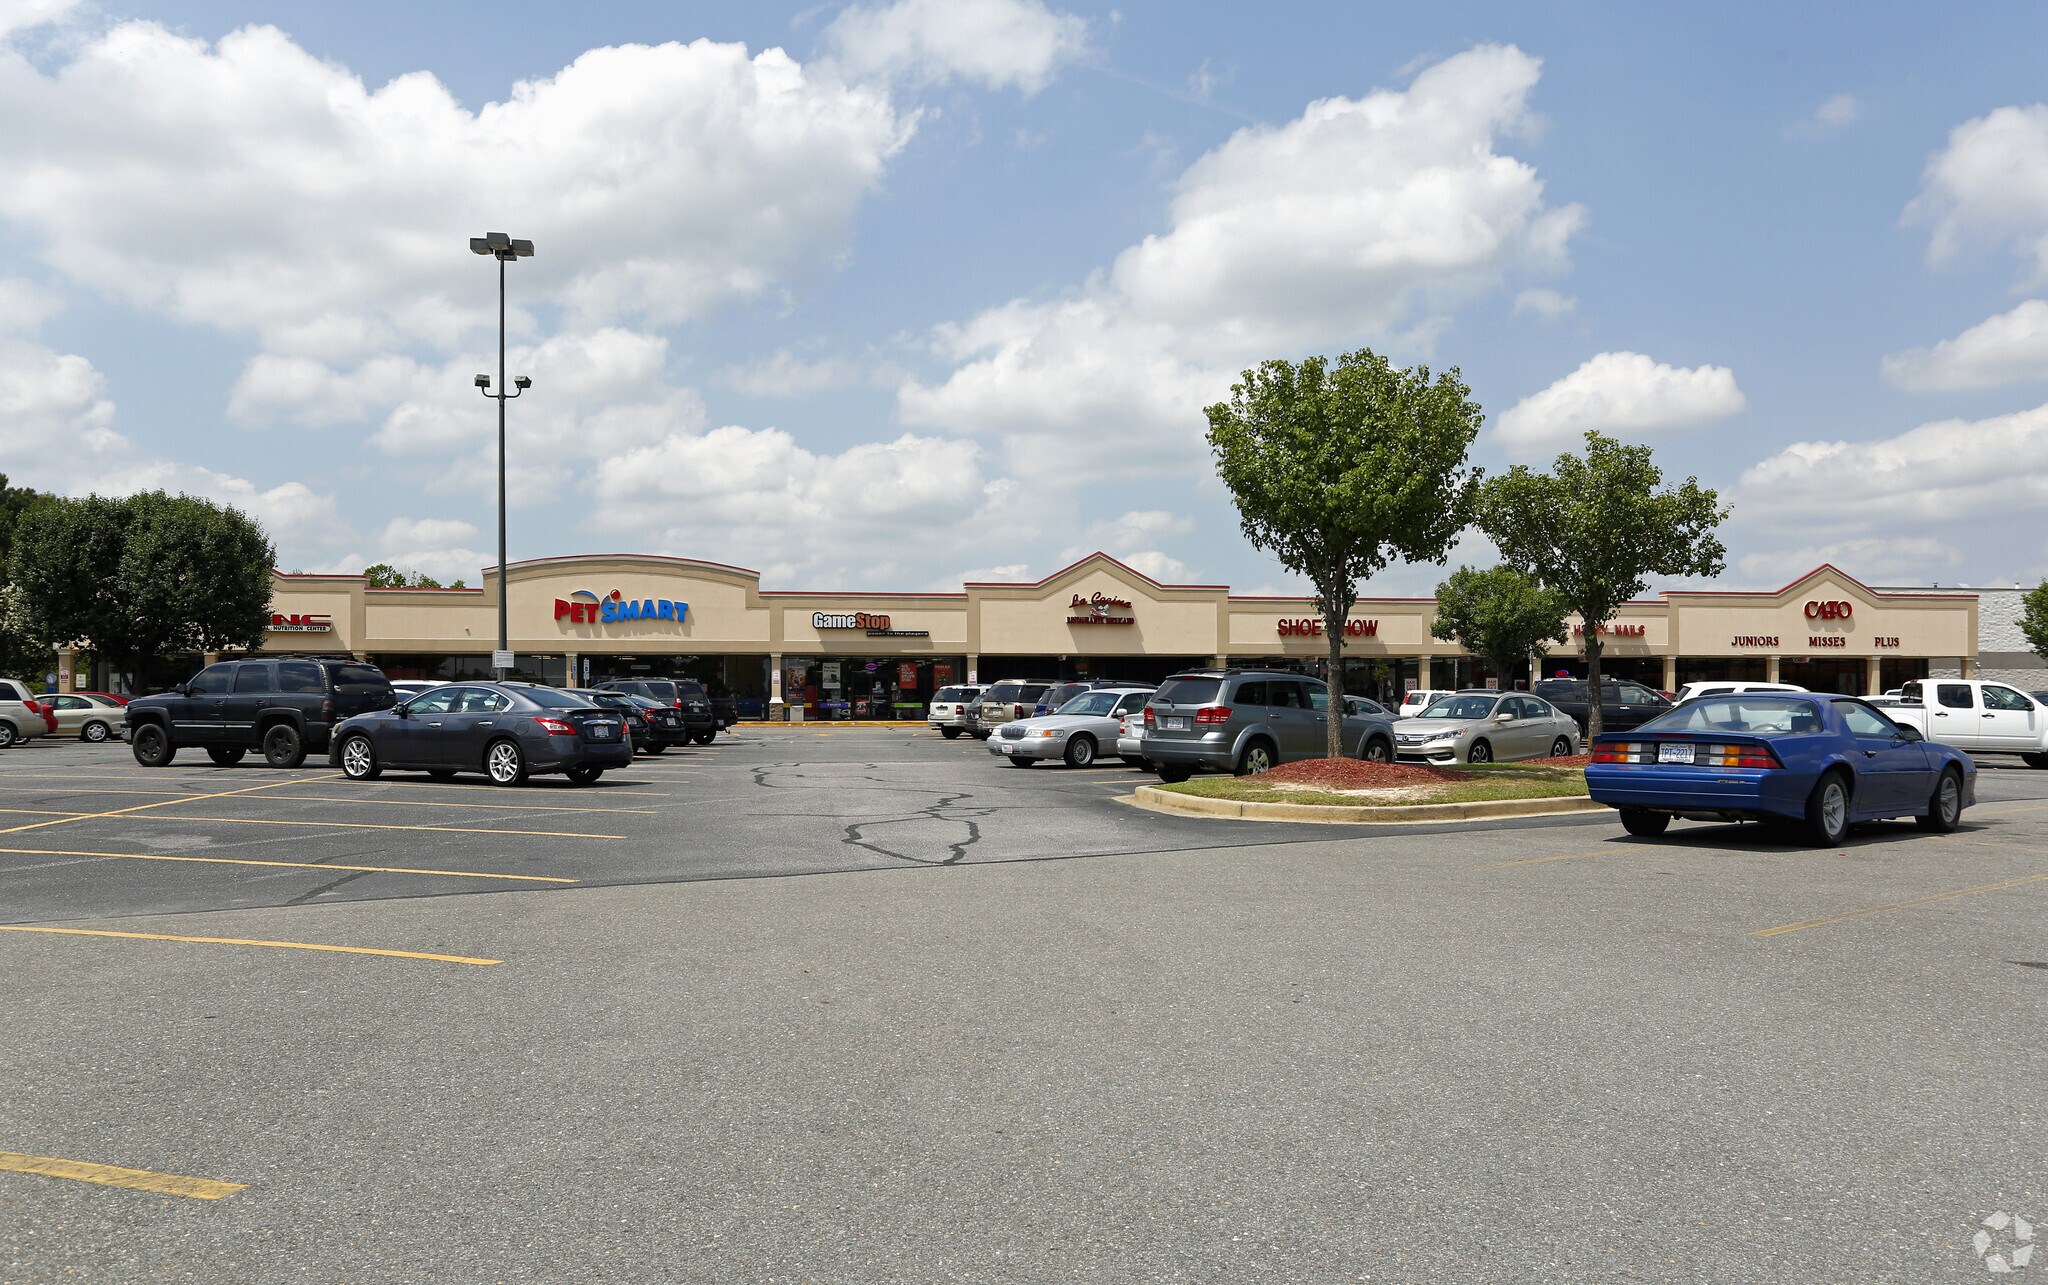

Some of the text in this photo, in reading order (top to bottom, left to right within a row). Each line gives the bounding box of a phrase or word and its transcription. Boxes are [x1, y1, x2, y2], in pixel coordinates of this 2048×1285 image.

[1069, 592, 1132, 608] La Cocina
[1803, 601, 1852, 619] CATO
[271, 614, 331, 625] NC
[812, 612, 890, 630] GameStop
[1278, 619, 1378, 636] SHOE HOW
[1614, 625, 1646, 636] NAILS
[1731, 636, 1779, 646] JUNIORS
[1808, 637, 1846, 647] MISSES
[1874, 637, 1899, 647] PLUS
